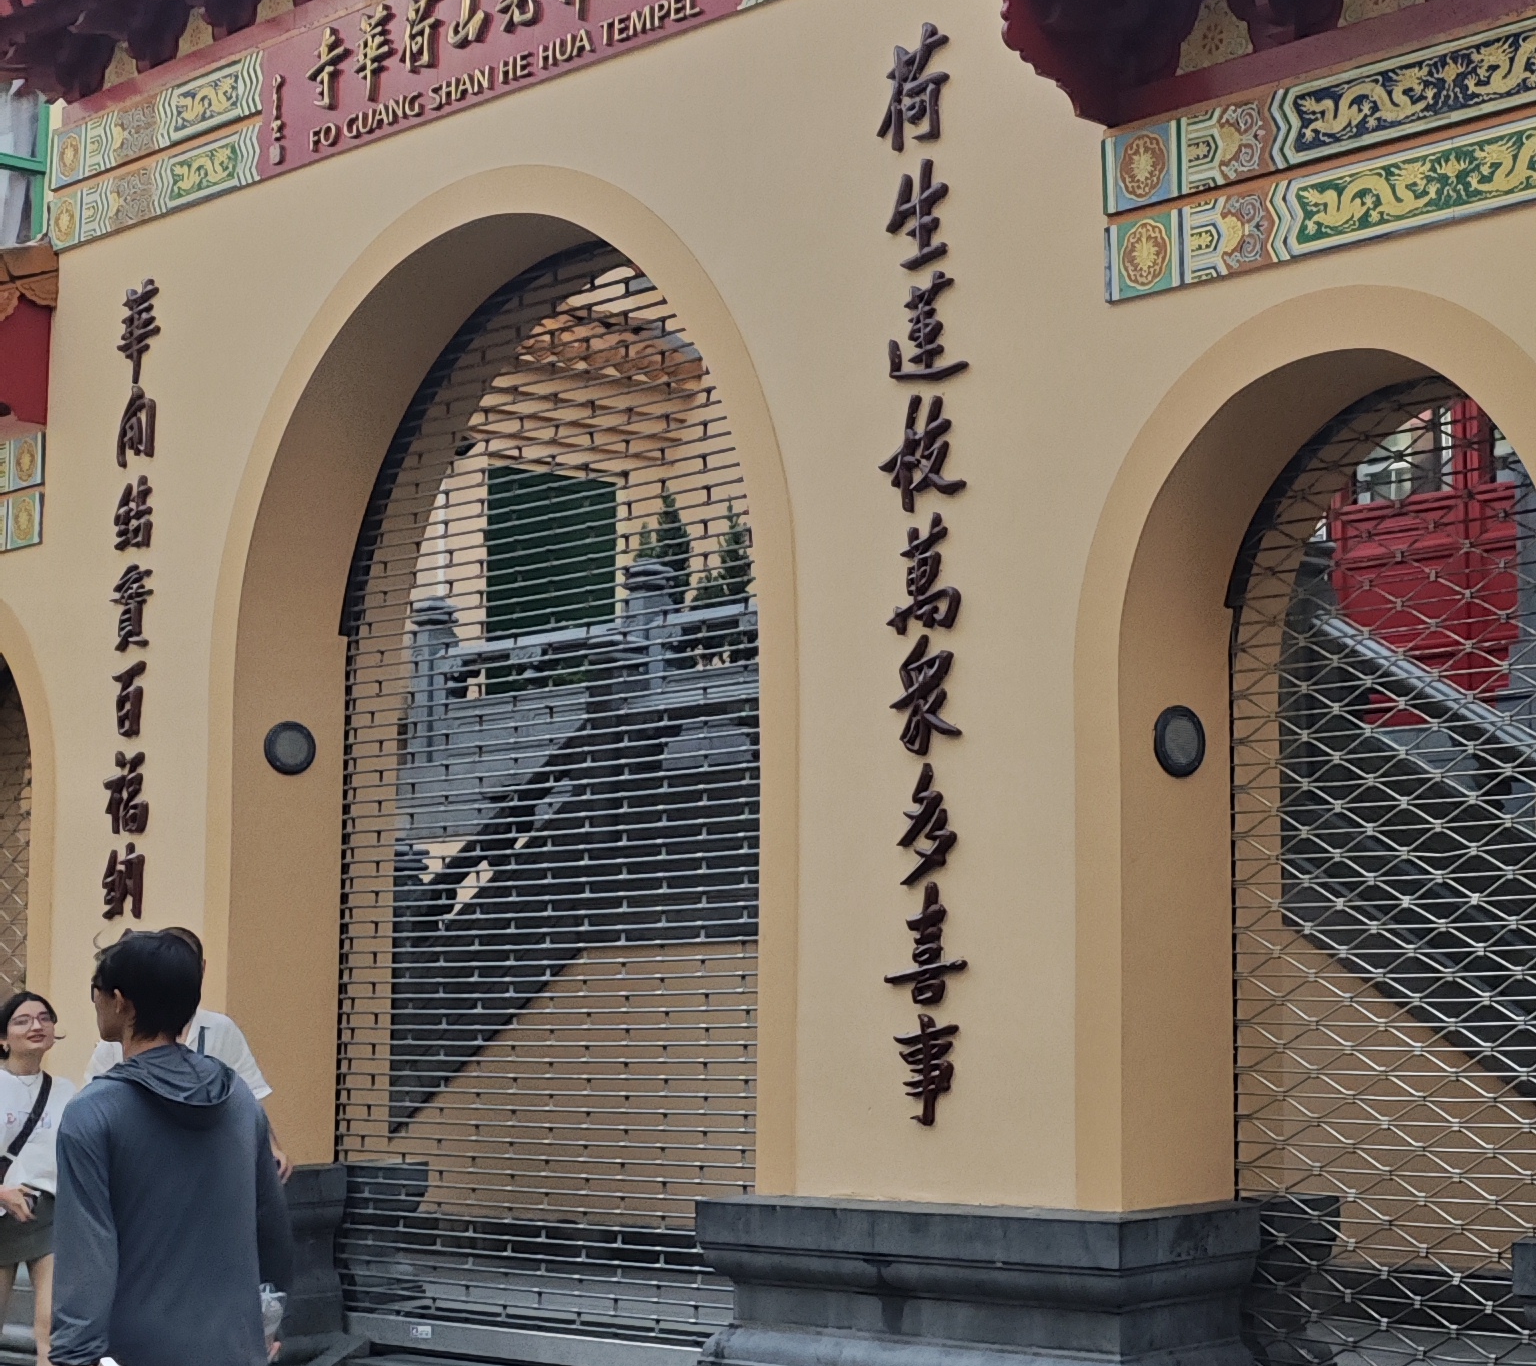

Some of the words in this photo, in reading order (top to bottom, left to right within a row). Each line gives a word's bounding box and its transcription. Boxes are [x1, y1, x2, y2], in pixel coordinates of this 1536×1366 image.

[309, 122, 338, 153] FO
[343, 91, 423, 138] GUANG
[428, 65, 492, 110] SHAN
[499, 51, 532, 84] HE
[538, 28, 593, 68] HUA
